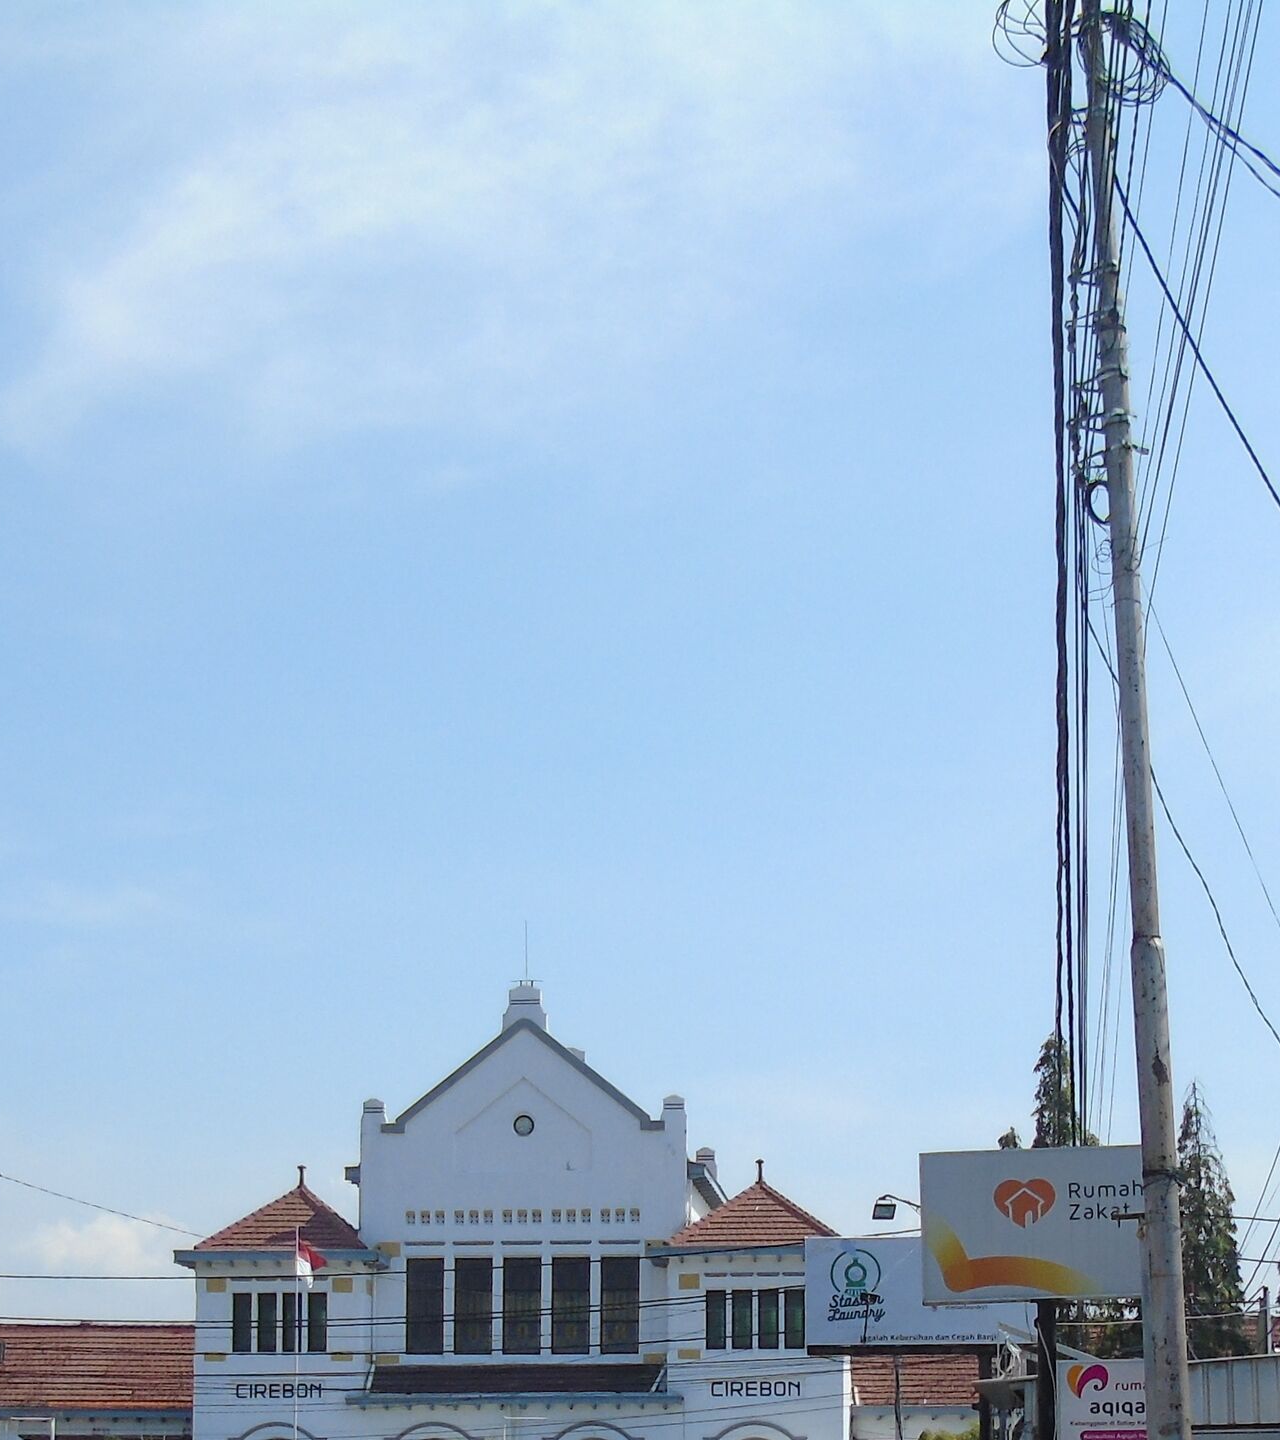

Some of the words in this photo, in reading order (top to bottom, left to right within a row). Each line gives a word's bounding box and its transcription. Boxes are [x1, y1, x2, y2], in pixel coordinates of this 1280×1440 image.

[1068, 1180, 1143, 1199] Rumah
[829, 1293, 884, 1308] Stasn
[827, 1307, 886, 1322] Laundry
[236, 1383, 322, 1399] CIREBON
[708, 1381, 801, 1397] CIREBON
